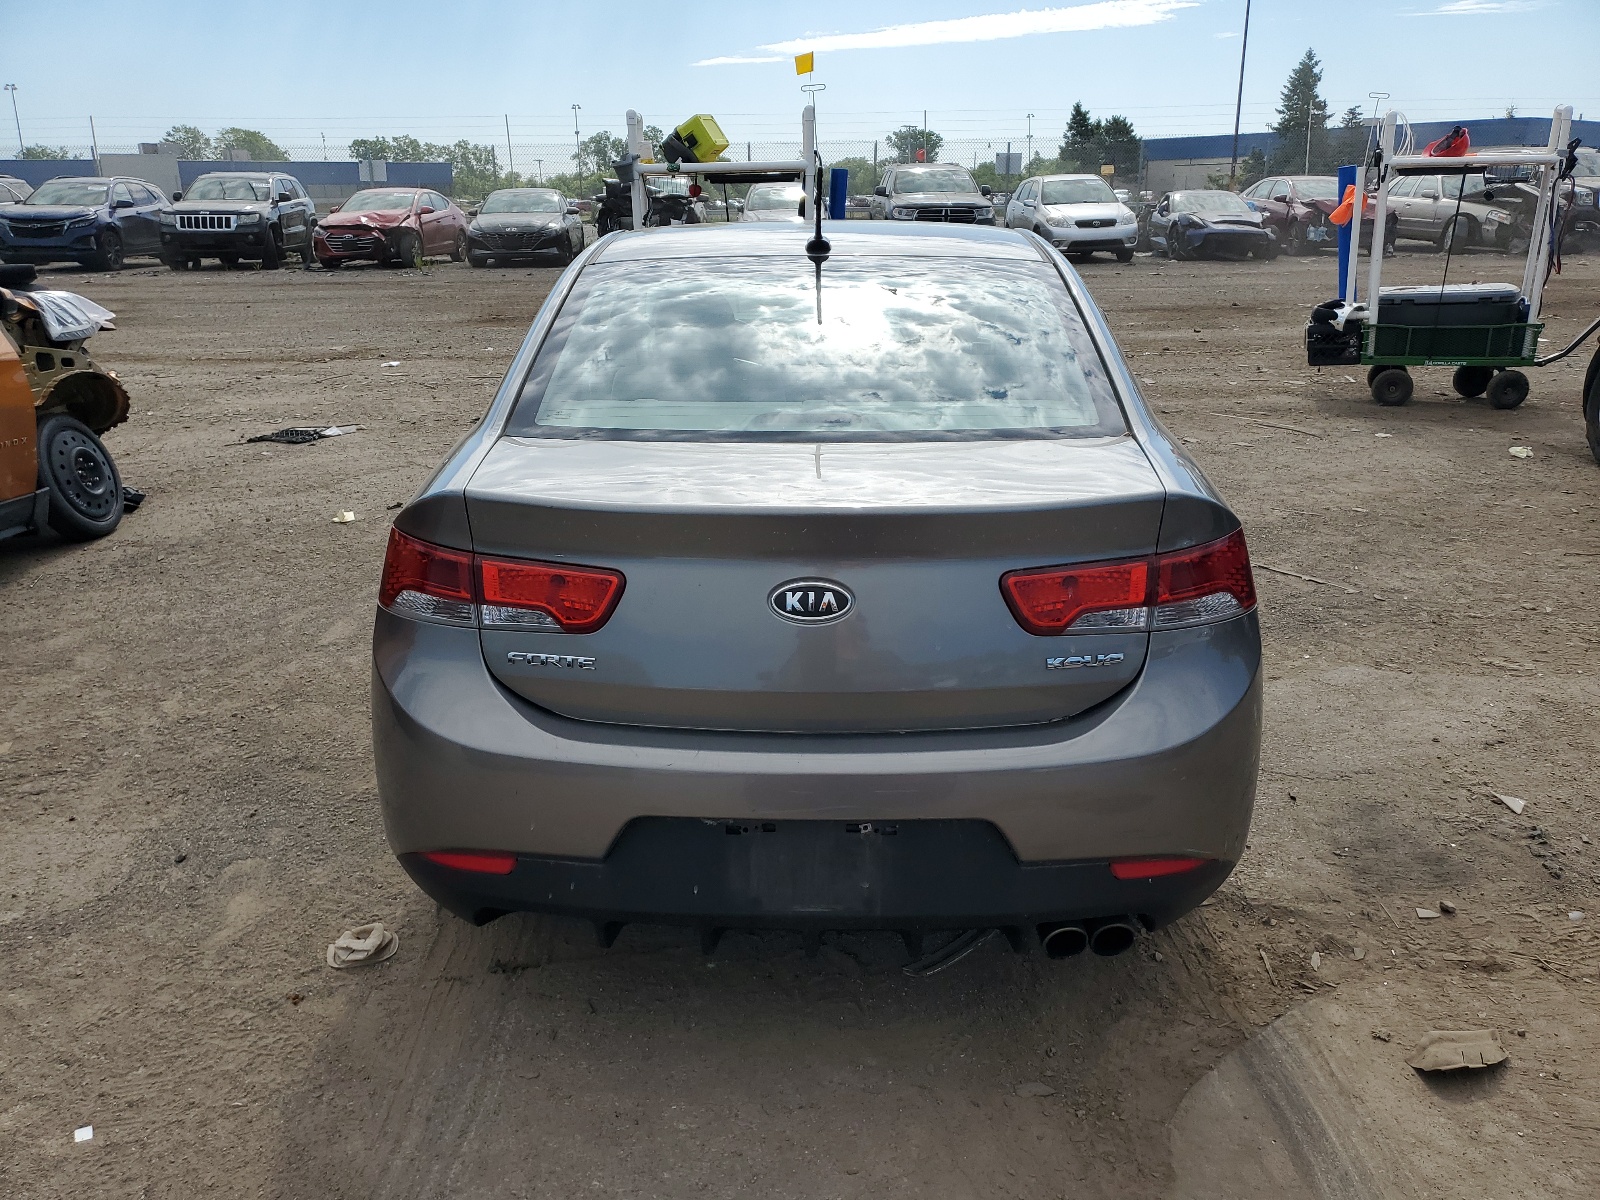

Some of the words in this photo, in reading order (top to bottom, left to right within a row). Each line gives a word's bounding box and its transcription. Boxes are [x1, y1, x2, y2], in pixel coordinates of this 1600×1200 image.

[784, 591, 839, 613] KIA
[507, 651, 597, 671] FORTE
[1046, 652, 1125, 670] KOUP
